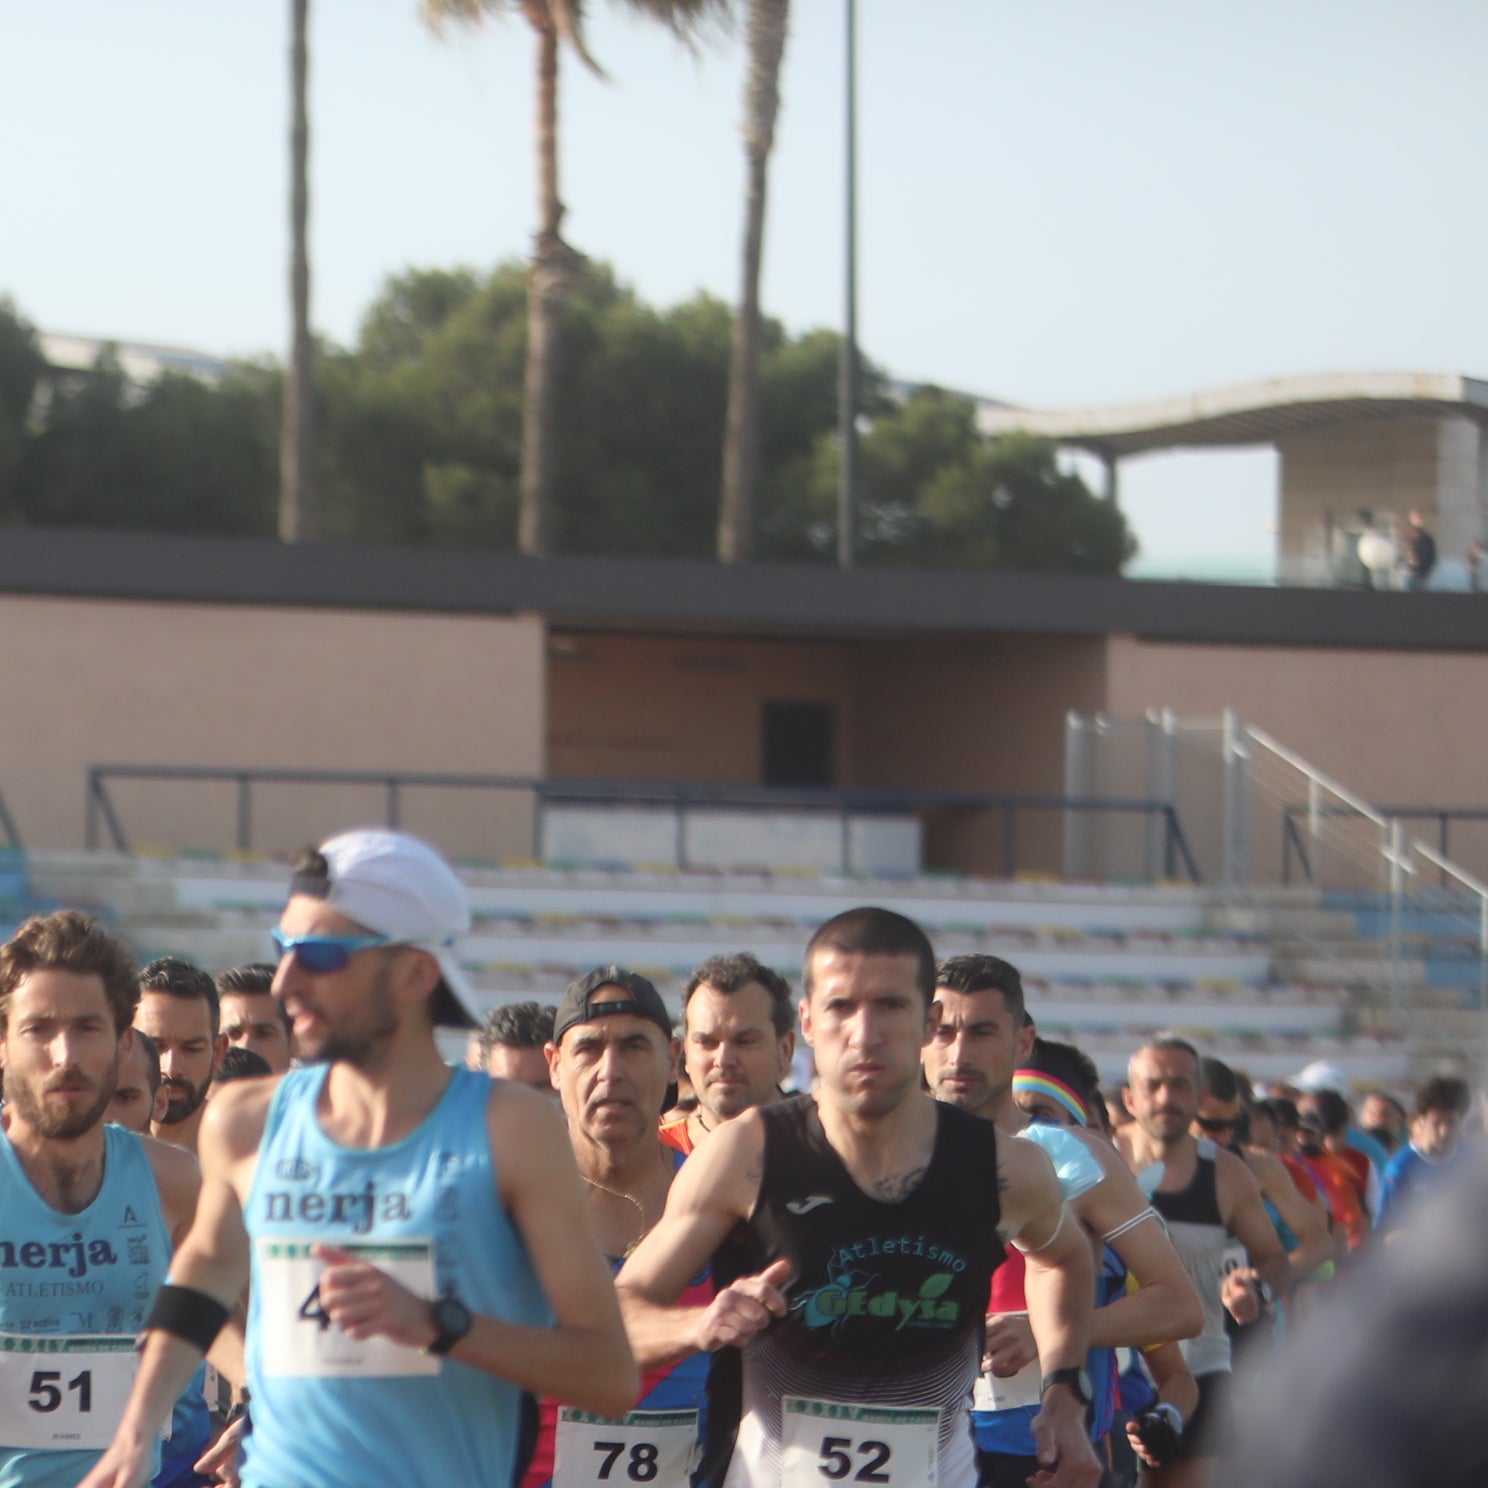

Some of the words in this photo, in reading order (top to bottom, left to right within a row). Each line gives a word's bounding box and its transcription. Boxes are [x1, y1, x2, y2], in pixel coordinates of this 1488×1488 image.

[263, 1180, 413, 1236] nerja
[838, 1236, 968, 1274] Atletismo
[5, 1279, 105, 1298] ATLETISMO
[27, 1369, 93, 1413] 51
[593, 1440, 659, 1483] 78
[817, 1436, 892, 1485] 52
